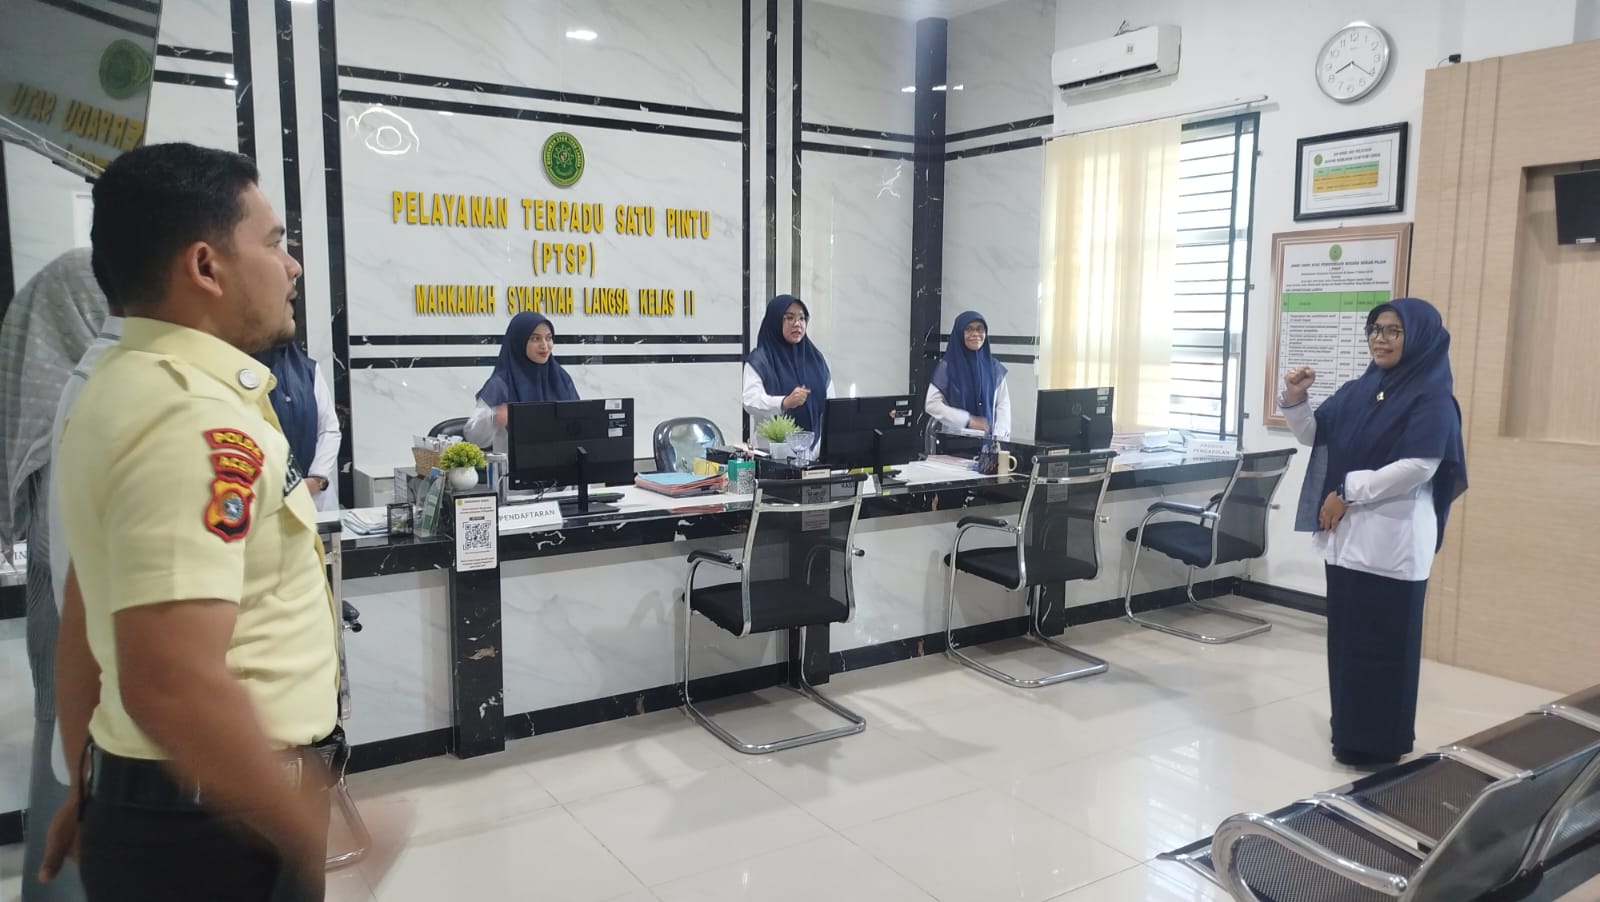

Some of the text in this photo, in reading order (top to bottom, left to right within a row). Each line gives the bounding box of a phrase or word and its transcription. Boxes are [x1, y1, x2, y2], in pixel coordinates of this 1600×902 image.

[392, 191, 710, 239] PELAYANAN TERPADU SATU PINTU
[532, 239, 596, 277] (PTSP)
[415, 284, 496, 316] MAHKAMAH
[507, 286, 574, 315] SYAR'IYAH
[584, 287, 629, 316] LANGSA
[639, 288, 675, 317] KELAS
[212, 431, 262, 459] POLDA
[498, 509, 555, 522] PENDAFTARAN
